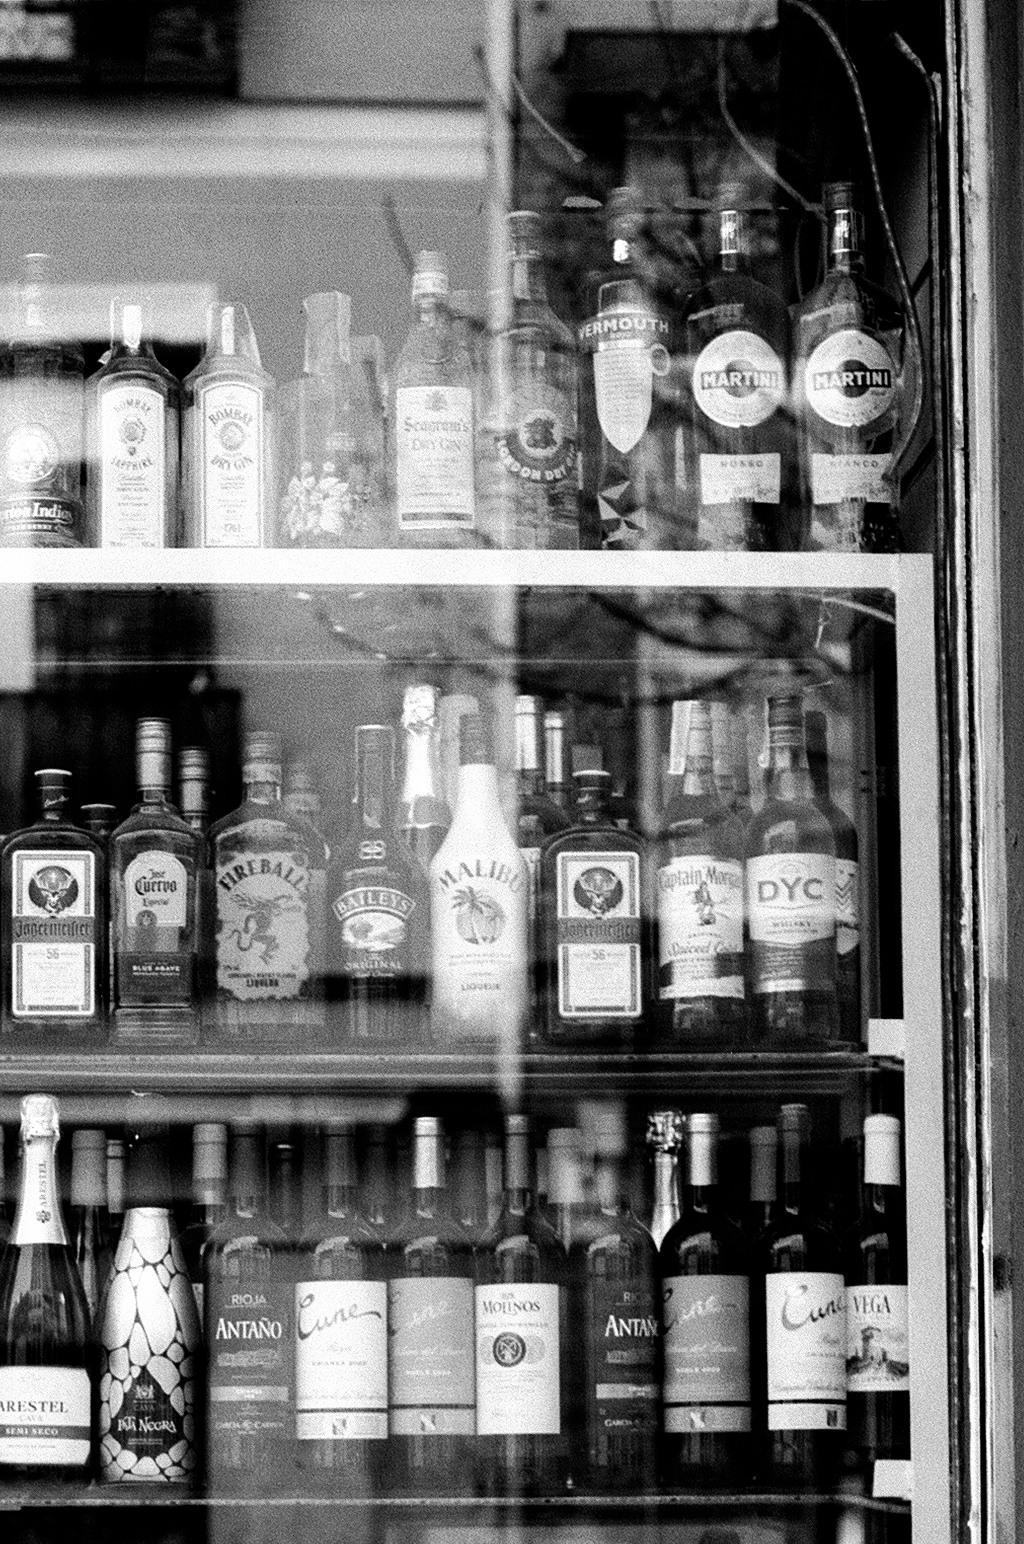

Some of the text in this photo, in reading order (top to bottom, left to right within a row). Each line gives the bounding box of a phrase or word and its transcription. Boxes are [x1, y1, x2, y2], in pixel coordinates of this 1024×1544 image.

[579, 317, 669, 340] VERMOUTH
[702, 370, 779, 389] MARTINI
[815, 370, 889, 388] MARTINI
[208, 408, 254, 426] BOMBAY
[218, 859, 309, 891] FIREBALL
[439, 859, 521, 894] MALIBU
[135, 877, 178, 895] Cuervo
[758, 878, 824, 902] DYC
[337, 890, 410, 914] BAILEYS
[15, 921, 92, 937] Jägermeister
[231, 1294, 267, 1305] RIOJA
[482, 1300, 540, 1316] MOLINOS
[781, 1284, 846, 1331] Cune
[853, 1297, 891, 1314] VEGA
[298, 1293, 382, 1341] Cune
[215, 1317, 282, 1340] ANTAÑO
[138, 1416, 177, 1433] NEGRA
